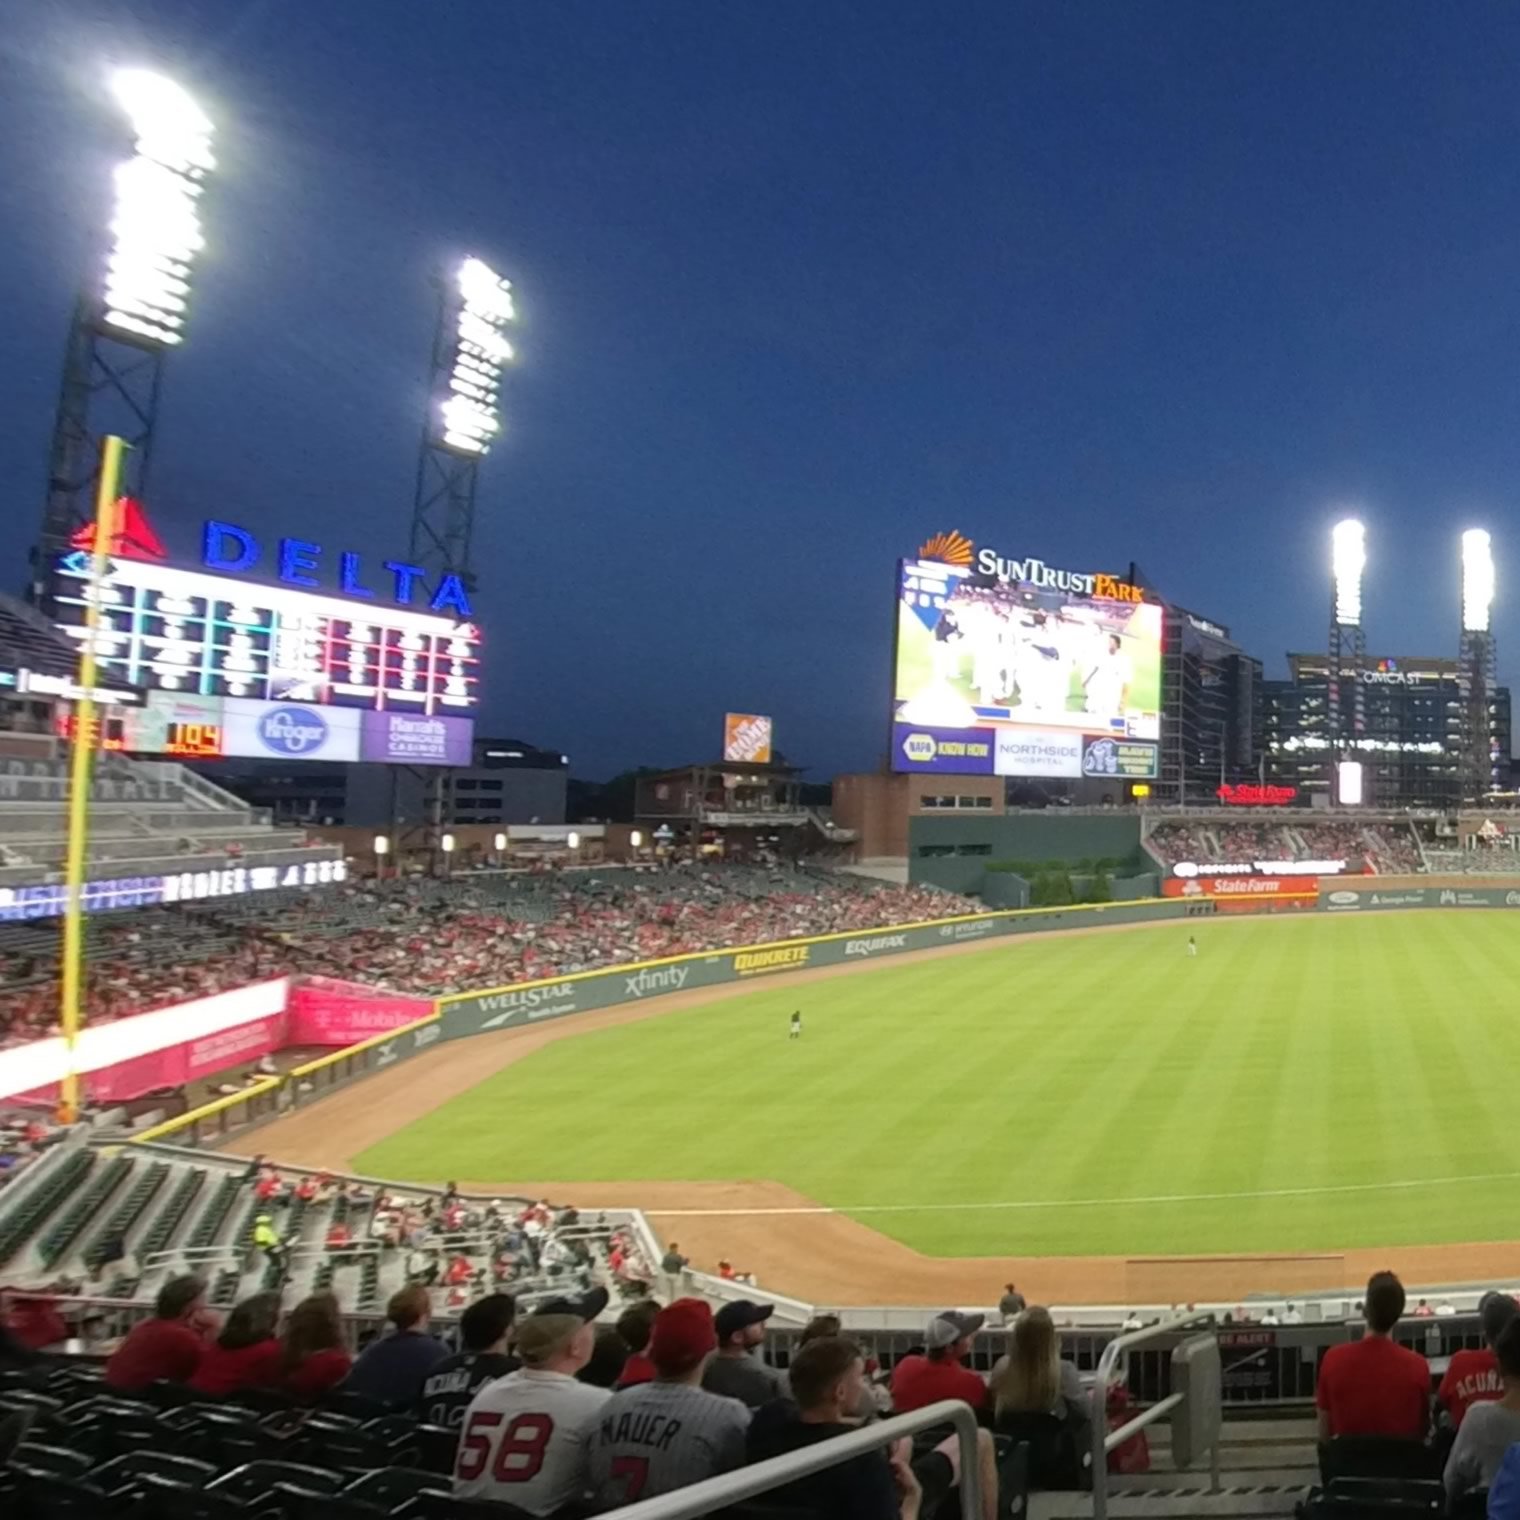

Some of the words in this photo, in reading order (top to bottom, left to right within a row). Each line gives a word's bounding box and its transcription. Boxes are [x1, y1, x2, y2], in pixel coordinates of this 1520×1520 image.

[204, 518, 474, 617] DELTA
[1094, 573, 1144, 603] PARK
[176, 722, 221, 746] 104
[265, 712, 325, 751] Kroger
[726, 717, 771, 759] HOME
[387, 741, 447, 754] CASINOS
[908, 741, 932, 754] NAPA
[999, 743, 1079, 758] NORTHSIDE
[1014, 756, 1065, 767] HOSPITAL
[734, 946, 811, 971] QUIKRETE
[844, 934, 907, 955] EQUIFAX
[625, 965, 690, 998] xfinity
[601, 1411, 682, 1452] MAUER
[457, 1412, 554, 1483] 58
[608, 1455, 649, 1504] 7
